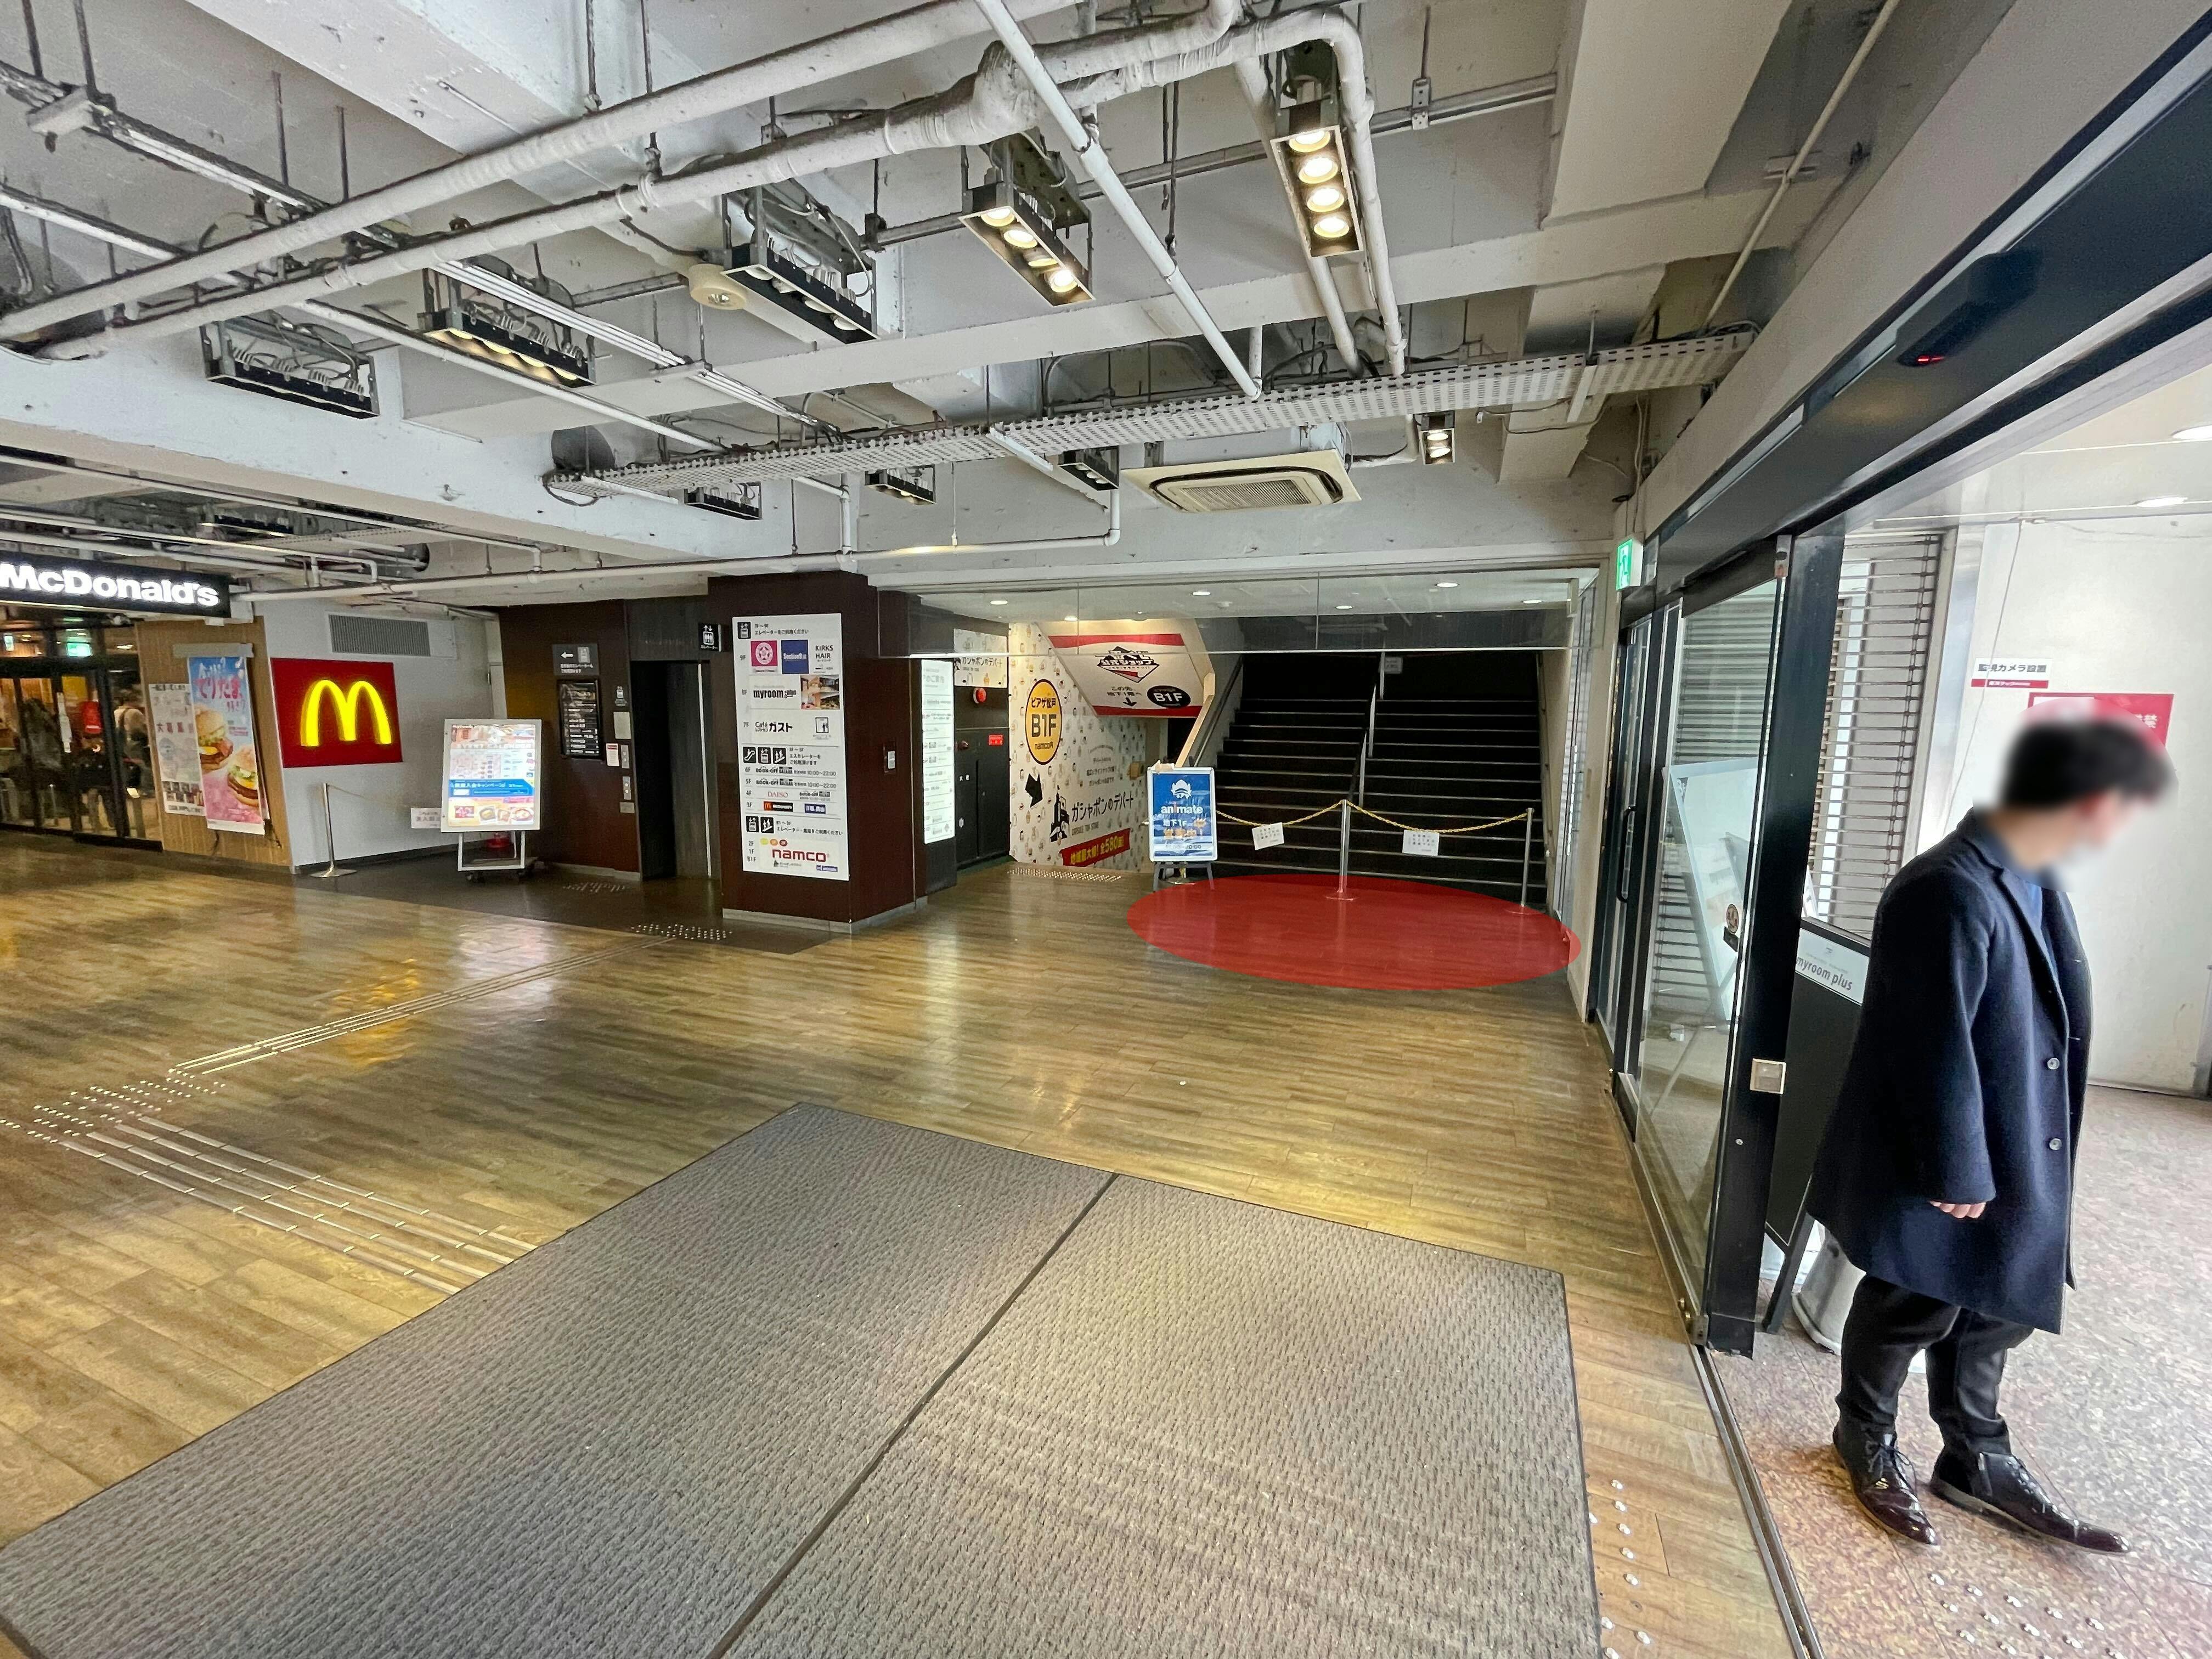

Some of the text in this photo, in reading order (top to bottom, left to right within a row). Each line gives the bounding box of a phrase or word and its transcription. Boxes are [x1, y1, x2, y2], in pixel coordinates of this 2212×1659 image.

[0, 563, 219, 606] McDonald's
[753, 690, 783, 698] myroom
[1154, 693, 1182, 702] B1F
[769, 721, 793, 732] ガスト
[1031, 714, 1057, 737] B1F
[1071, 791, 1134, 822] ガシャポンのデパート
[1161, 802, 1204, 814] animate
[772, 849, 826, 862] namco
[1796, 957, 1831, 980] myroom
[1831, 973, 1853, 990] plus
